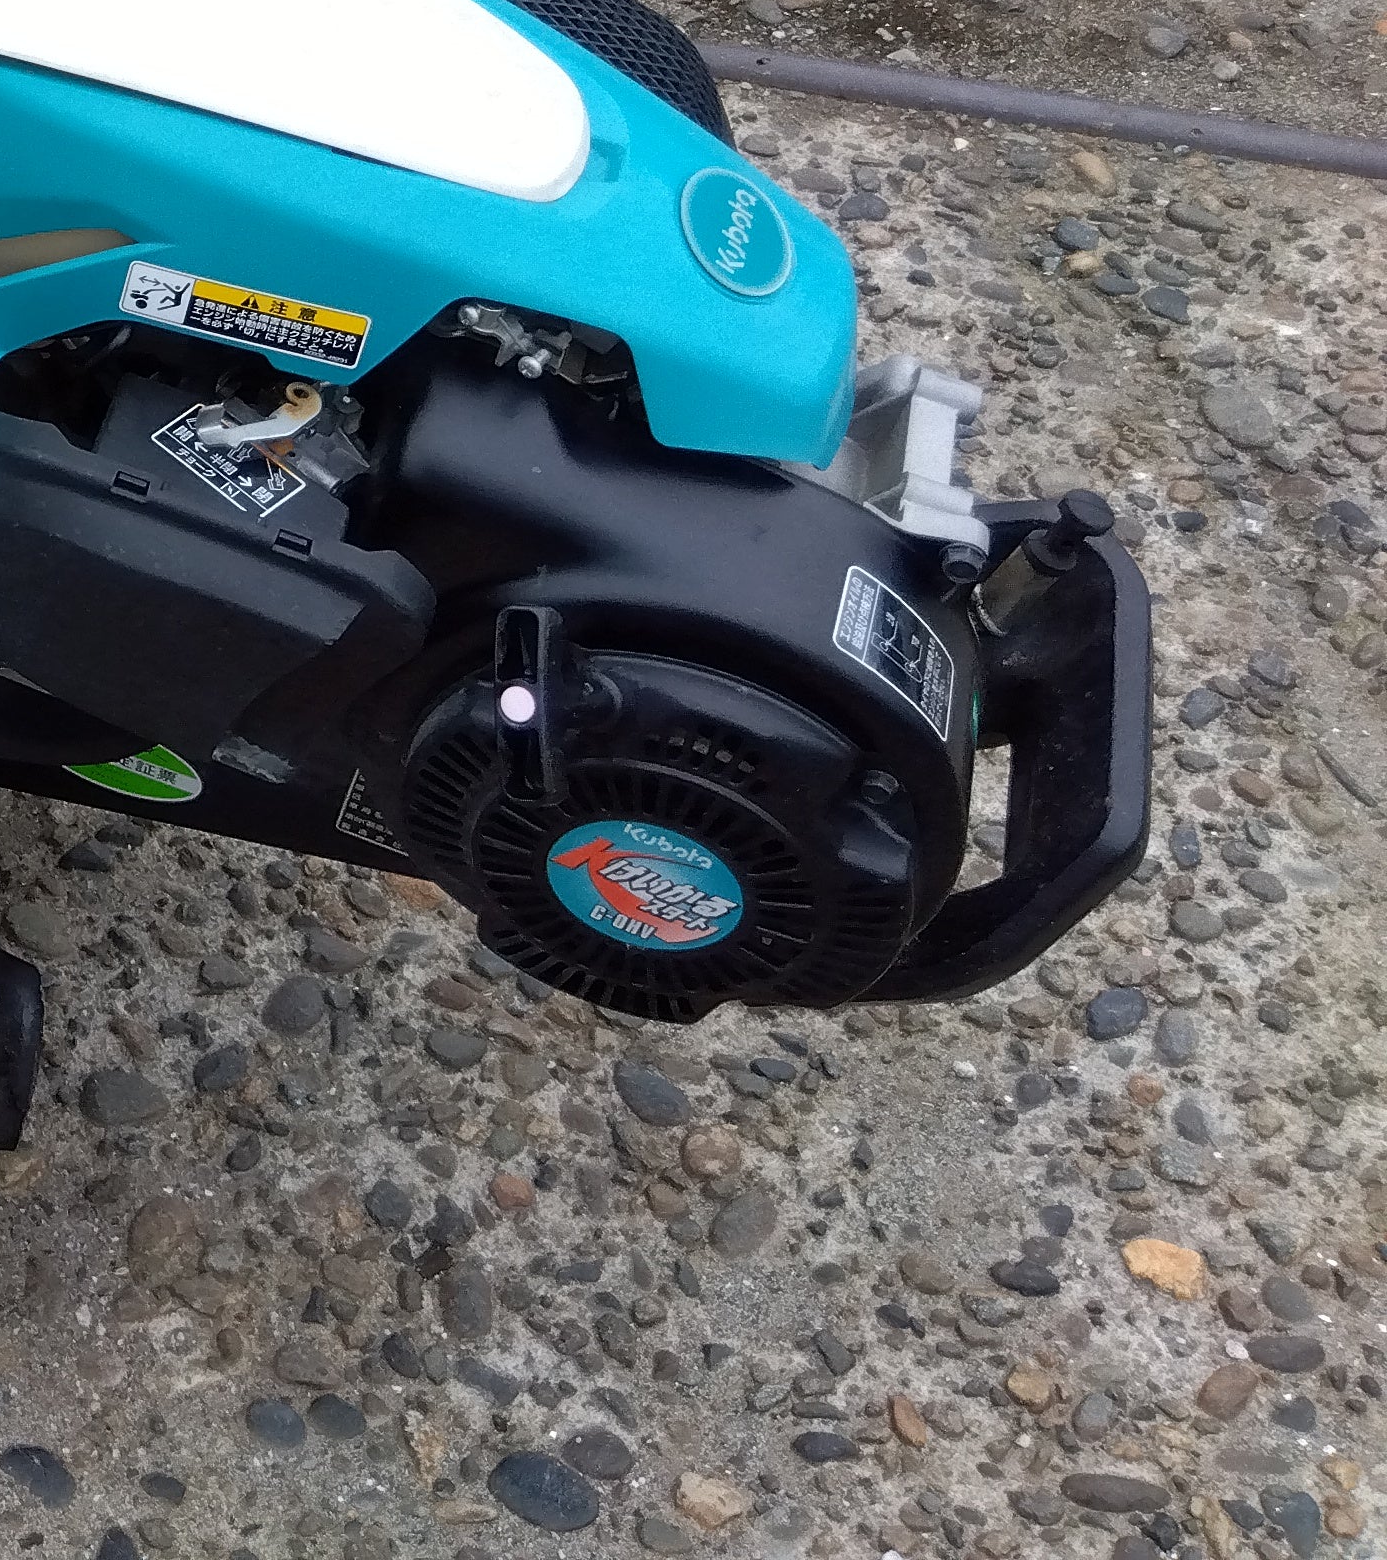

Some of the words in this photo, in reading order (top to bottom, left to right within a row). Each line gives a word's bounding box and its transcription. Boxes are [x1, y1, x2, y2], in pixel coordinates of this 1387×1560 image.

[715, 189, 757, 275] Kubota
[269, 301, 318, 323] 注意
[176, 447, 217, 477] チョーク
[839, 576, 863, 642] エンジンオイルの
[623, 823, 713, 870] Kubota
[590, 904, 659, 939] C-OHV
[638, 899, 710, 931] スタート
